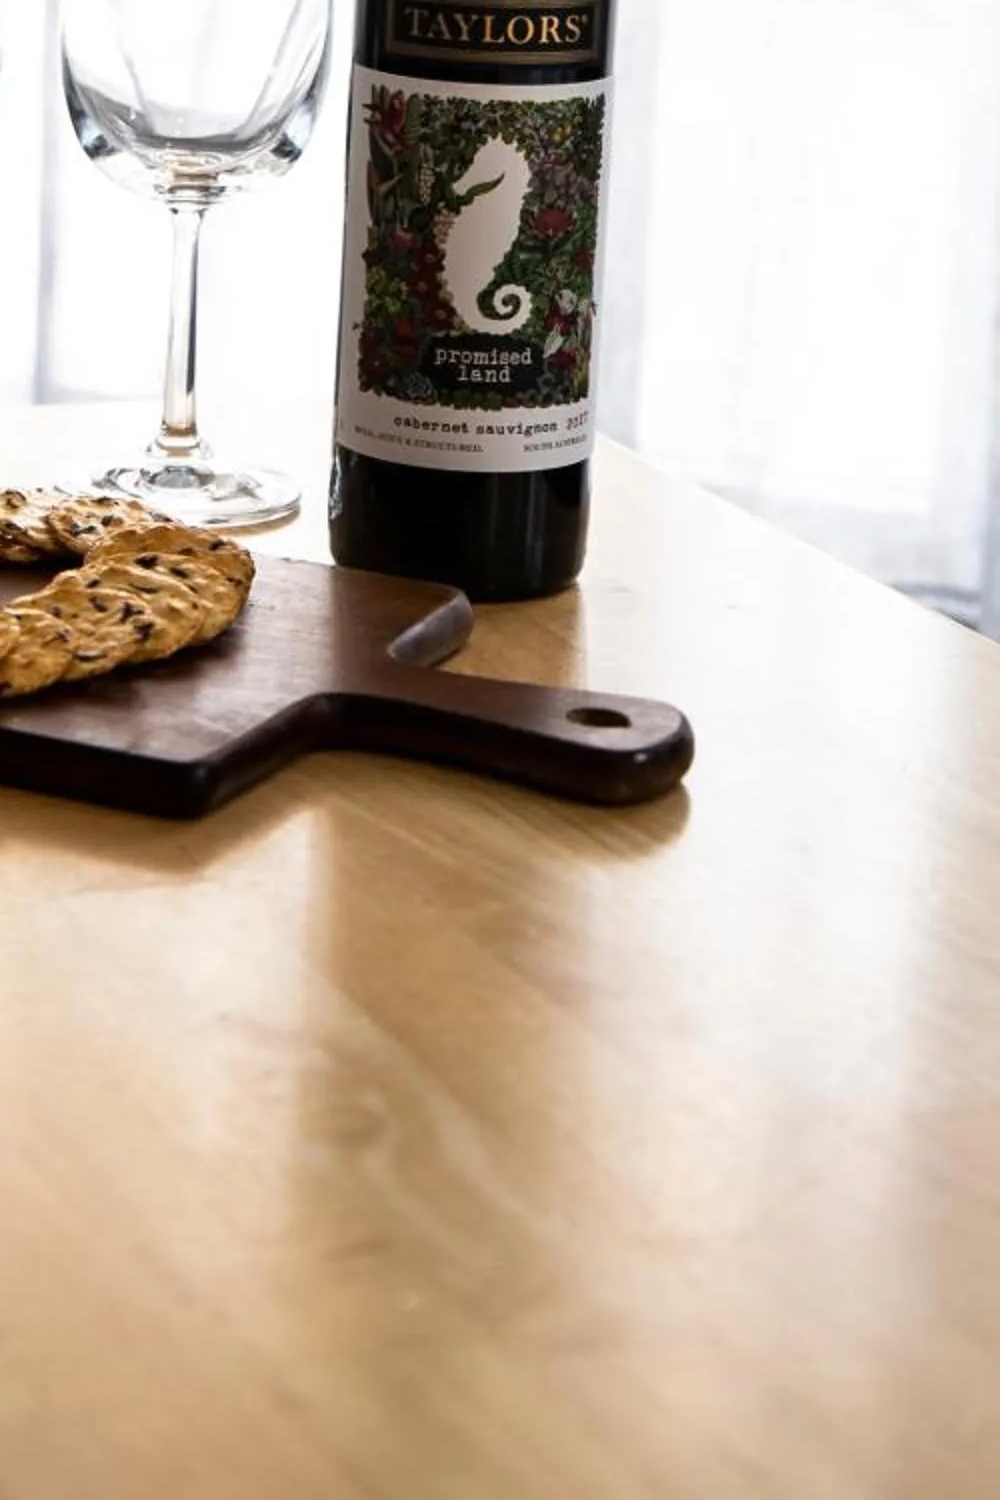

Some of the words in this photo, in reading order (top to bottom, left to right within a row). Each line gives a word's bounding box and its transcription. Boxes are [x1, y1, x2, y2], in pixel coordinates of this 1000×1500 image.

[403, 7, 582, 45] TAYLORS
[433, 347, 533, 366] promised
[457, 364, 511, 383] land
[393, 416, 469, 434] cabernet
[475, 422, 558, 438] sauvignon
